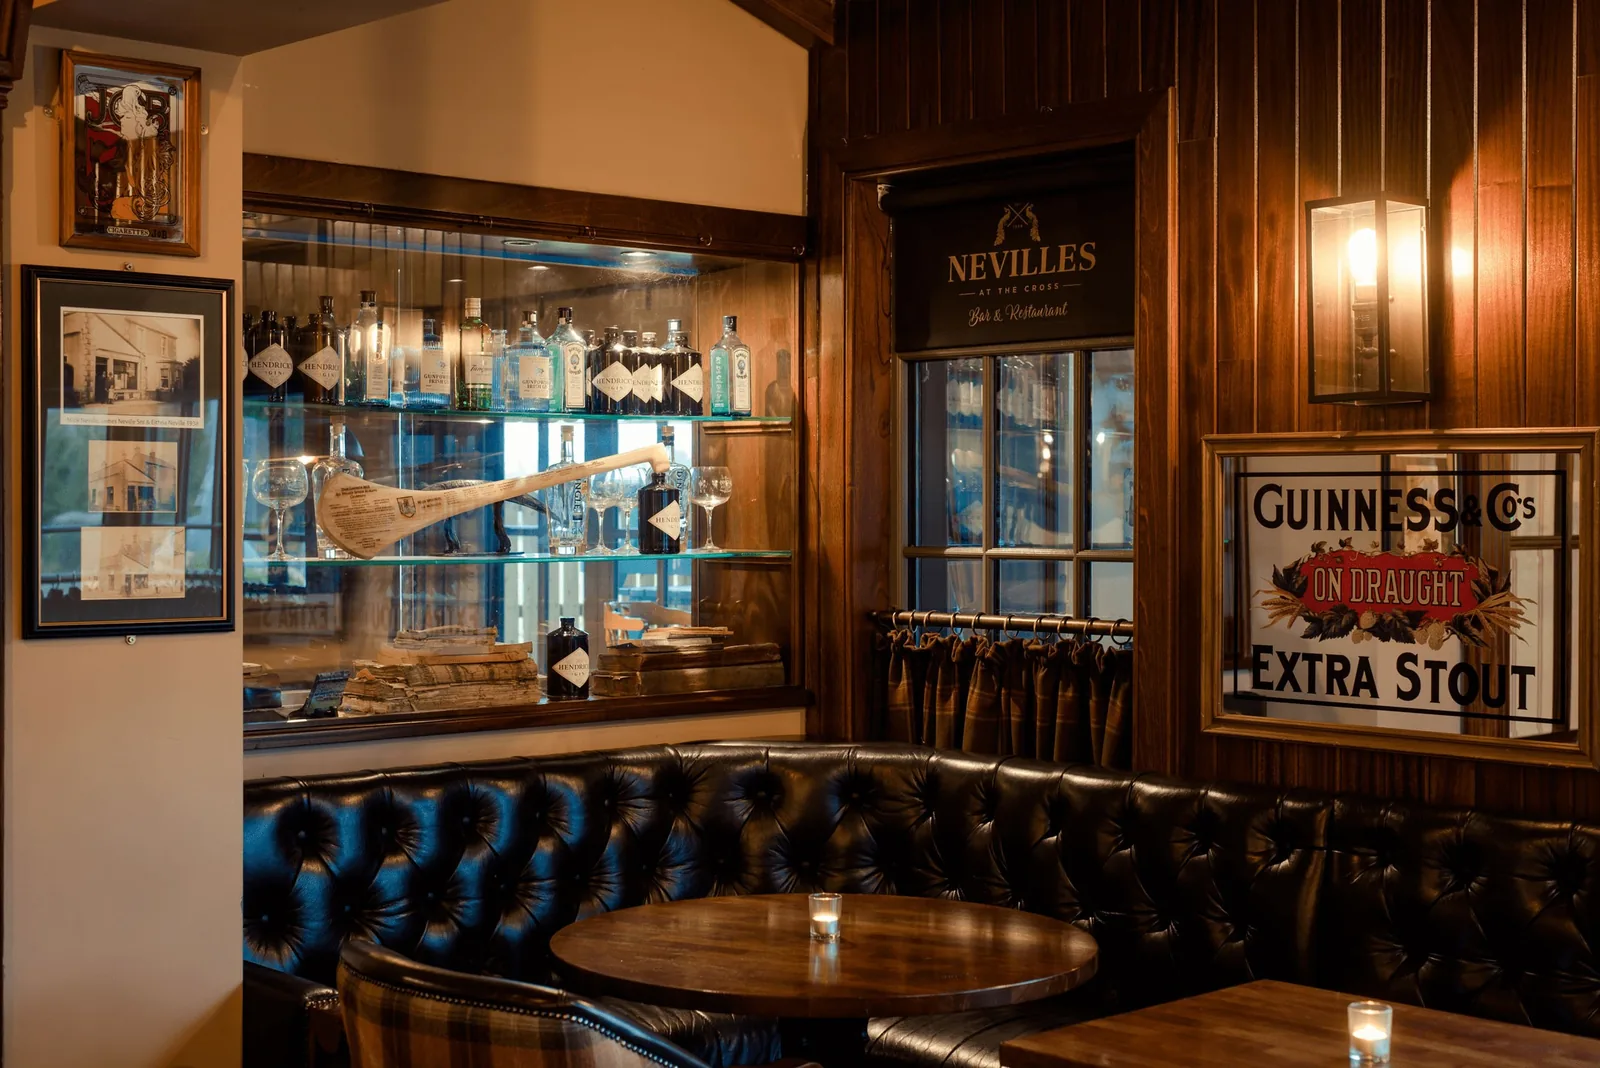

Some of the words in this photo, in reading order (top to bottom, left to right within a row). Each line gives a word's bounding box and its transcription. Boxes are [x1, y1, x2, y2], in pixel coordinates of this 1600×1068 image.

[107, 227, 150, 236] CIGARETTES
[947, 241, 1097, 283] NEVILLES
[978, 288, 991, 296] AT
[998, 286, 1018, 295] THE
[1024, 282, 1060, 293] CROSS
[968, 306, 992, 327] Bar
[993, 308, 1004, 322] &
[1005, 301, 1068, 321] Restaurant
[573, 477, 582, 512] INGLE
[1253, 483, 1457, 533] GUINNESS
[1459, 494, 1483, 528] &
[1313, 566, 1343, 603] ON
[1349, 566, 1465, 608] DRAUGHT
[1251, 644, 1380, 699] EXTRA
[1395, 652, 1537, 711] STOUT
